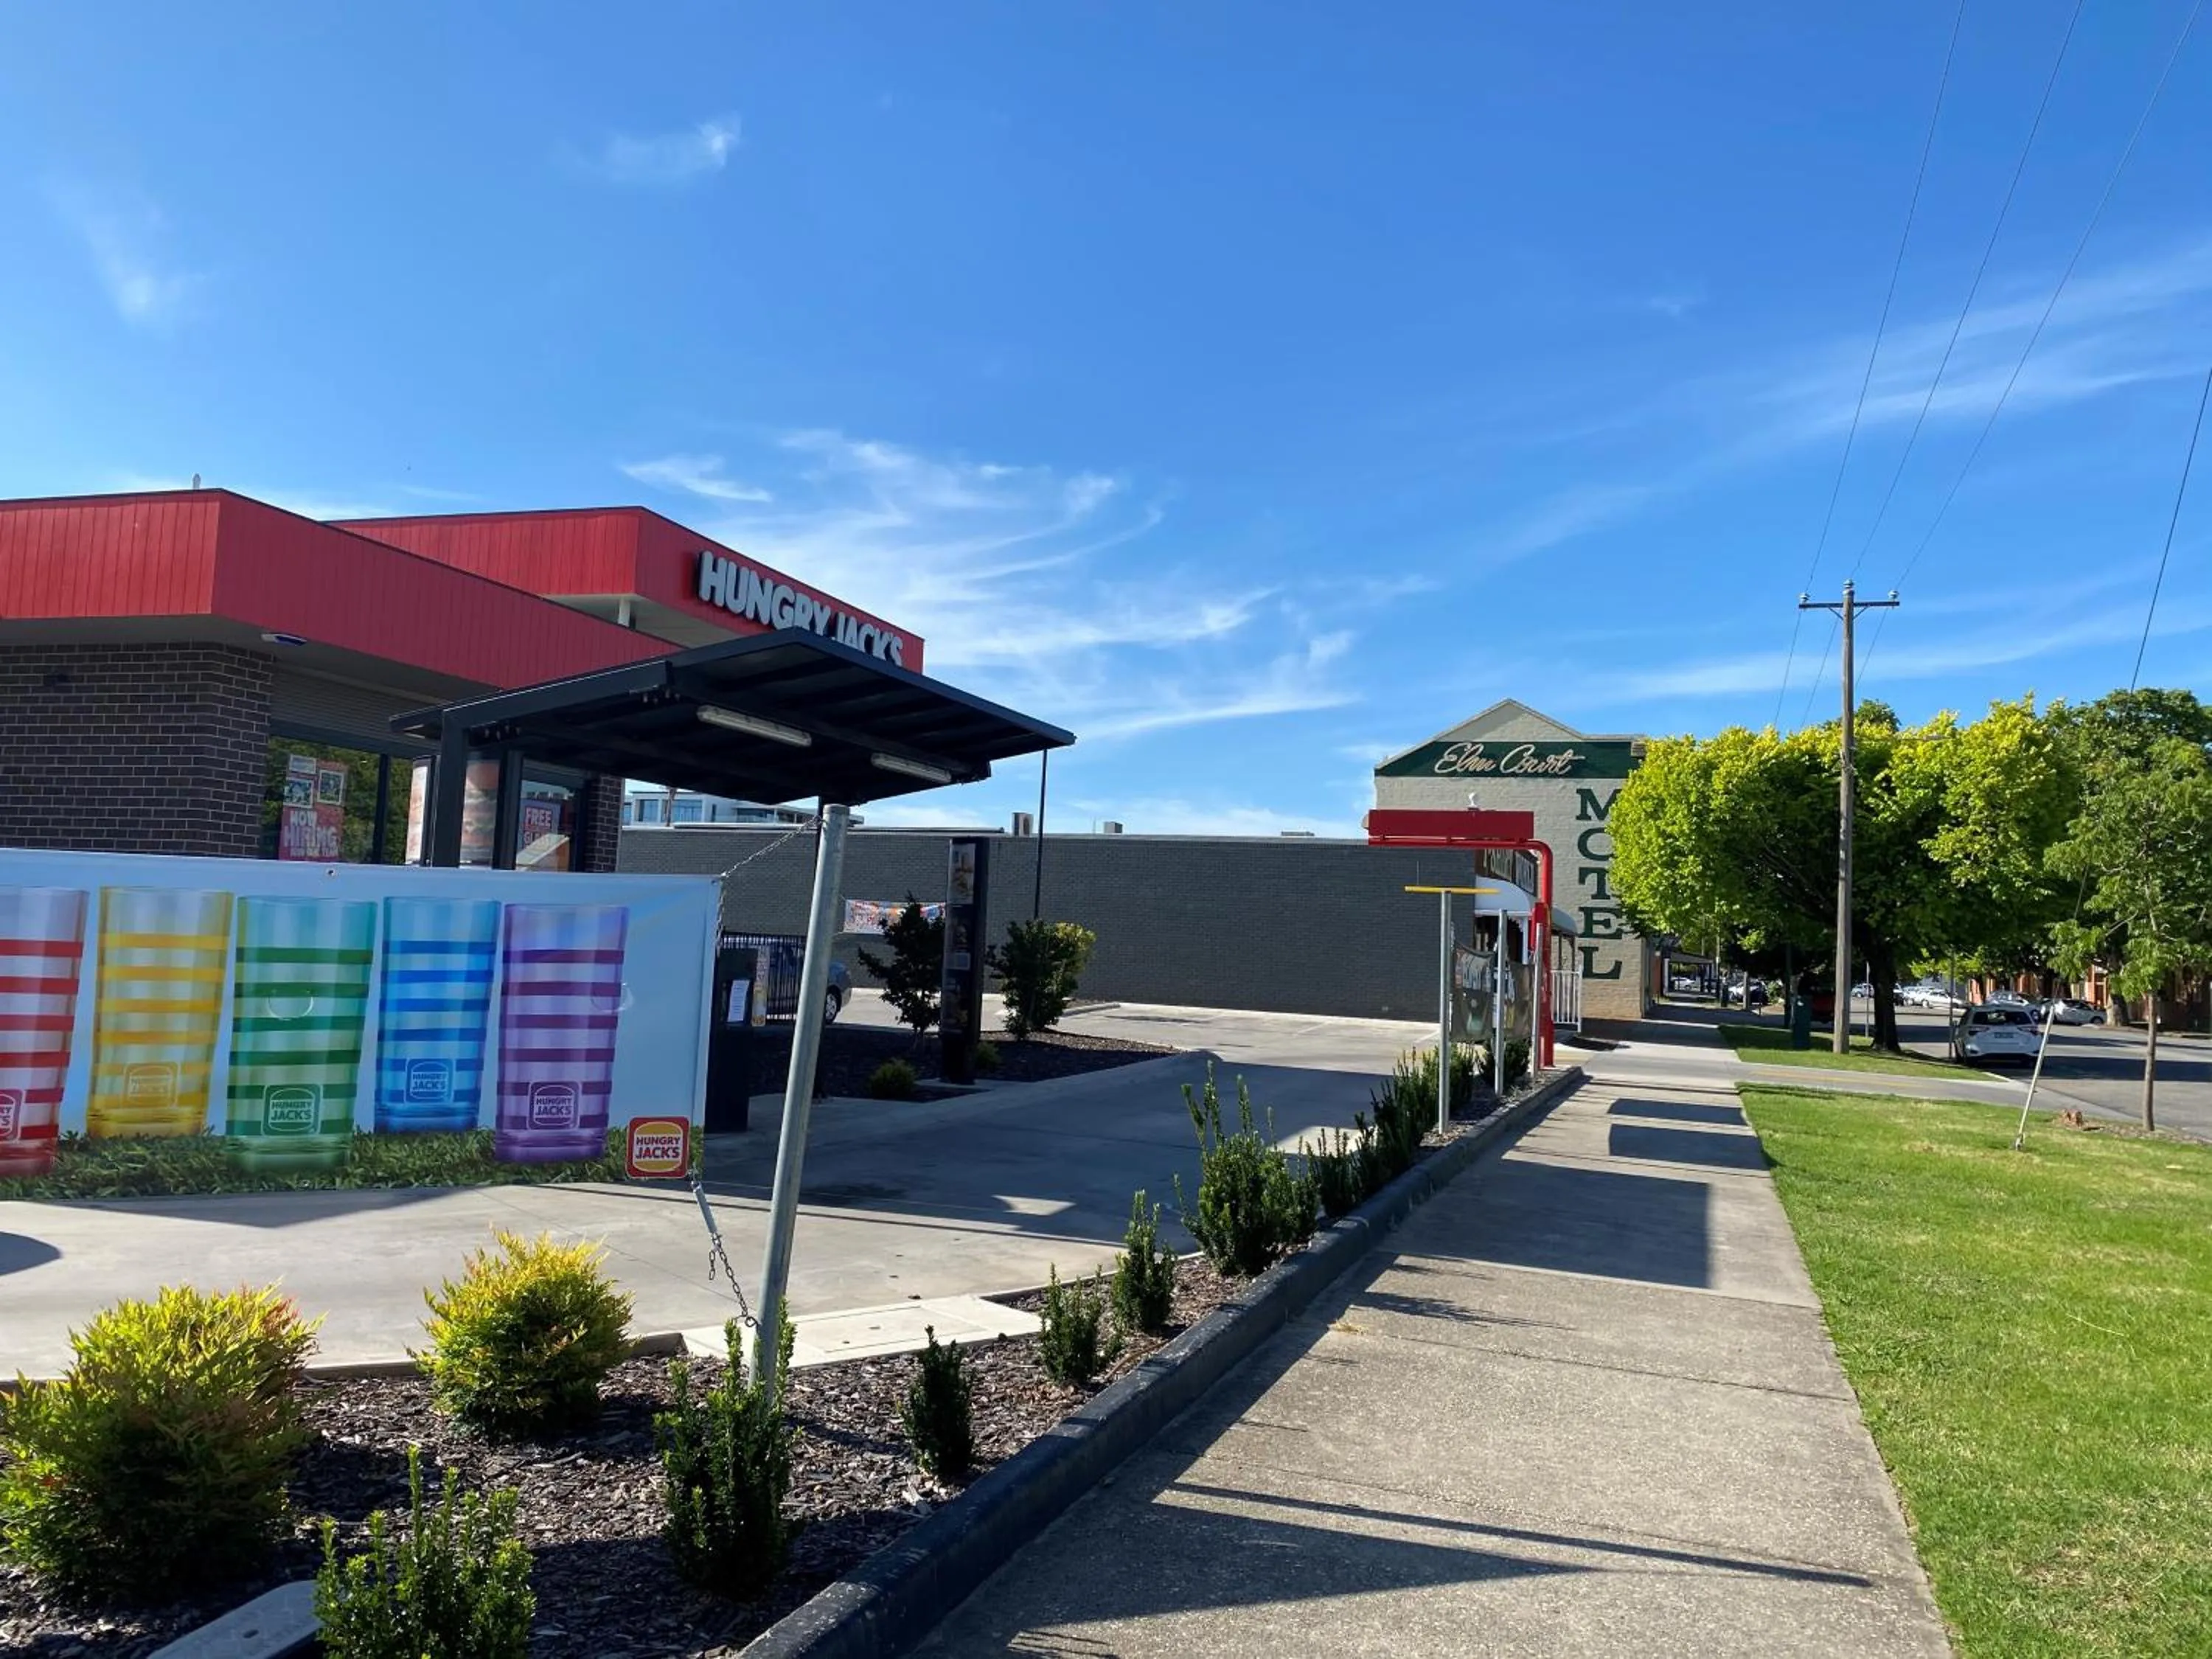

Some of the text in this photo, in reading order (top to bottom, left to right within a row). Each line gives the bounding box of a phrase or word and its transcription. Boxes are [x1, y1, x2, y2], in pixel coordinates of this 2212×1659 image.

[699, 551, 903, 667] HUNGRY JACK'S
[1434, 742, 1586, 775] Elm Court
[290, 810, 318, 827] NOW
[526, 807, 552, 827] FREE
[283, 825, 338, 849] HIRING
[1576, 788, 1624, 980] MOTEL
[271, 1101, 313, 1110] HUNGRY
[536, 1097, 573, 1105] HUNGRY
[636, 1136, 681, 1145] HUNGRY
